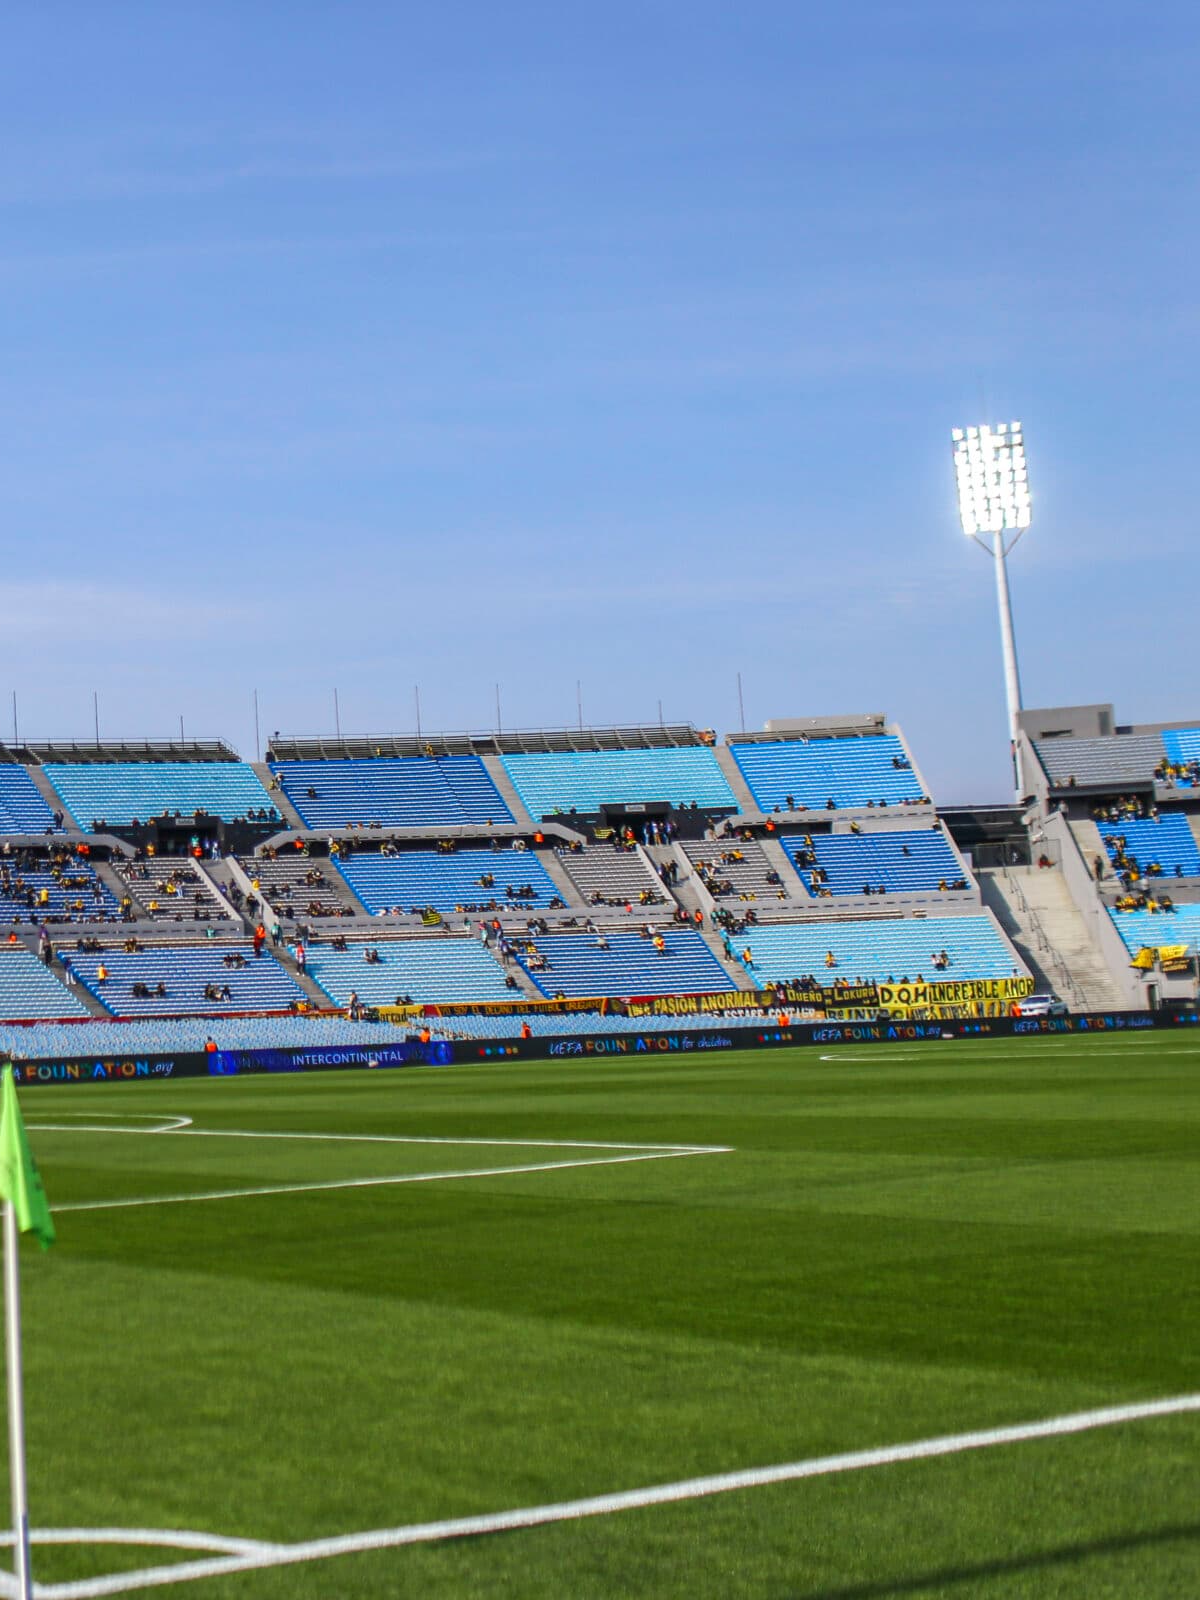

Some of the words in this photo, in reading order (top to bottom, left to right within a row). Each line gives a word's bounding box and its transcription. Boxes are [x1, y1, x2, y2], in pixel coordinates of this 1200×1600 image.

[931, 981, 999, 1002] INCREIBLE
[1005, 977, 1034, 999] AMOR
[701, 992, 758, 1011] ANORMAL
[813, 1029, 841, 1041] UEFA
[550, 1041, 583, 1055] UEFA
[292, 1051, 404, 1066] INTERCONTINENTAL
[25, 1061, 149, 1081] FOUNDATION
[152, 1062, 174, 1077] .org
